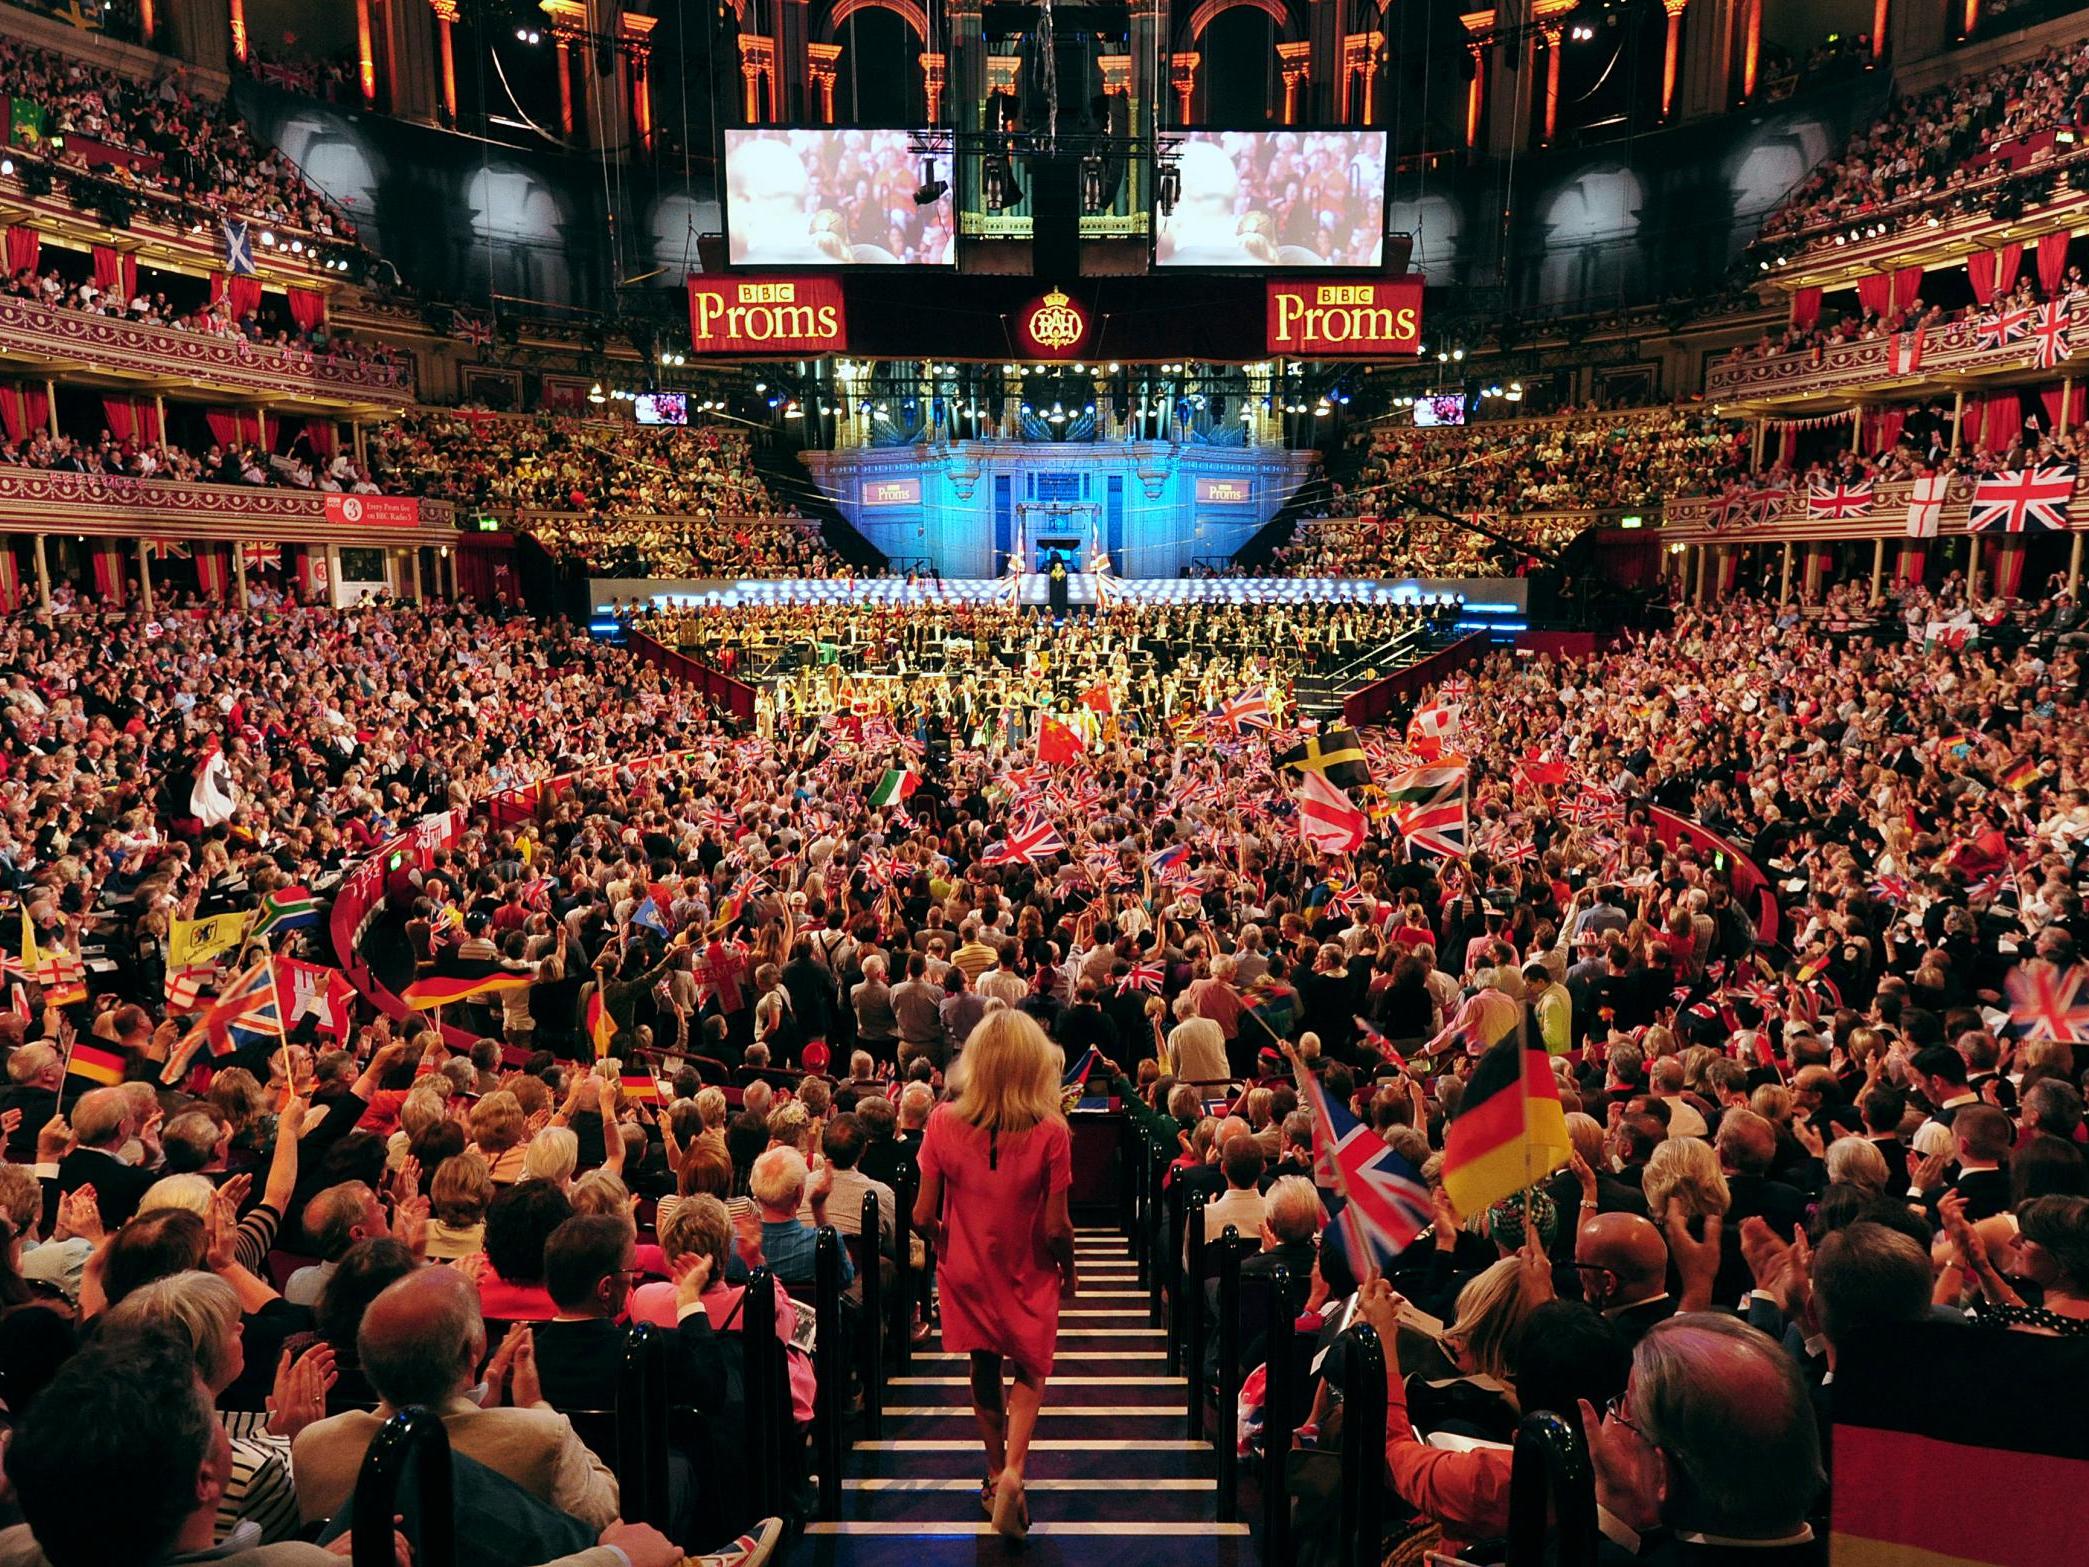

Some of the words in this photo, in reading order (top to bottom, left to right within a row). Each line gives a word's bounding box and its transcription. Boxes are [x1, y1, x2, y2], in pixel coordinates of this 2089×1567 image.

[741, 285, 792, 302] BBC
[1319, 288, 1372, 303] BBC
[695, 292, 838, 340] Proms
[1275, 294, 1416, 342] Proms
[878, 487, 910, 501] Proms
[1209, 486, 1241, 500] Proms
[366, 502, 383, 512] Every
[384, 503, 400, 511] Prom
[401, 503, 410, 512] live
[376, 512, 389, 520] BBC
[390, 513, 408, 521] Radio
